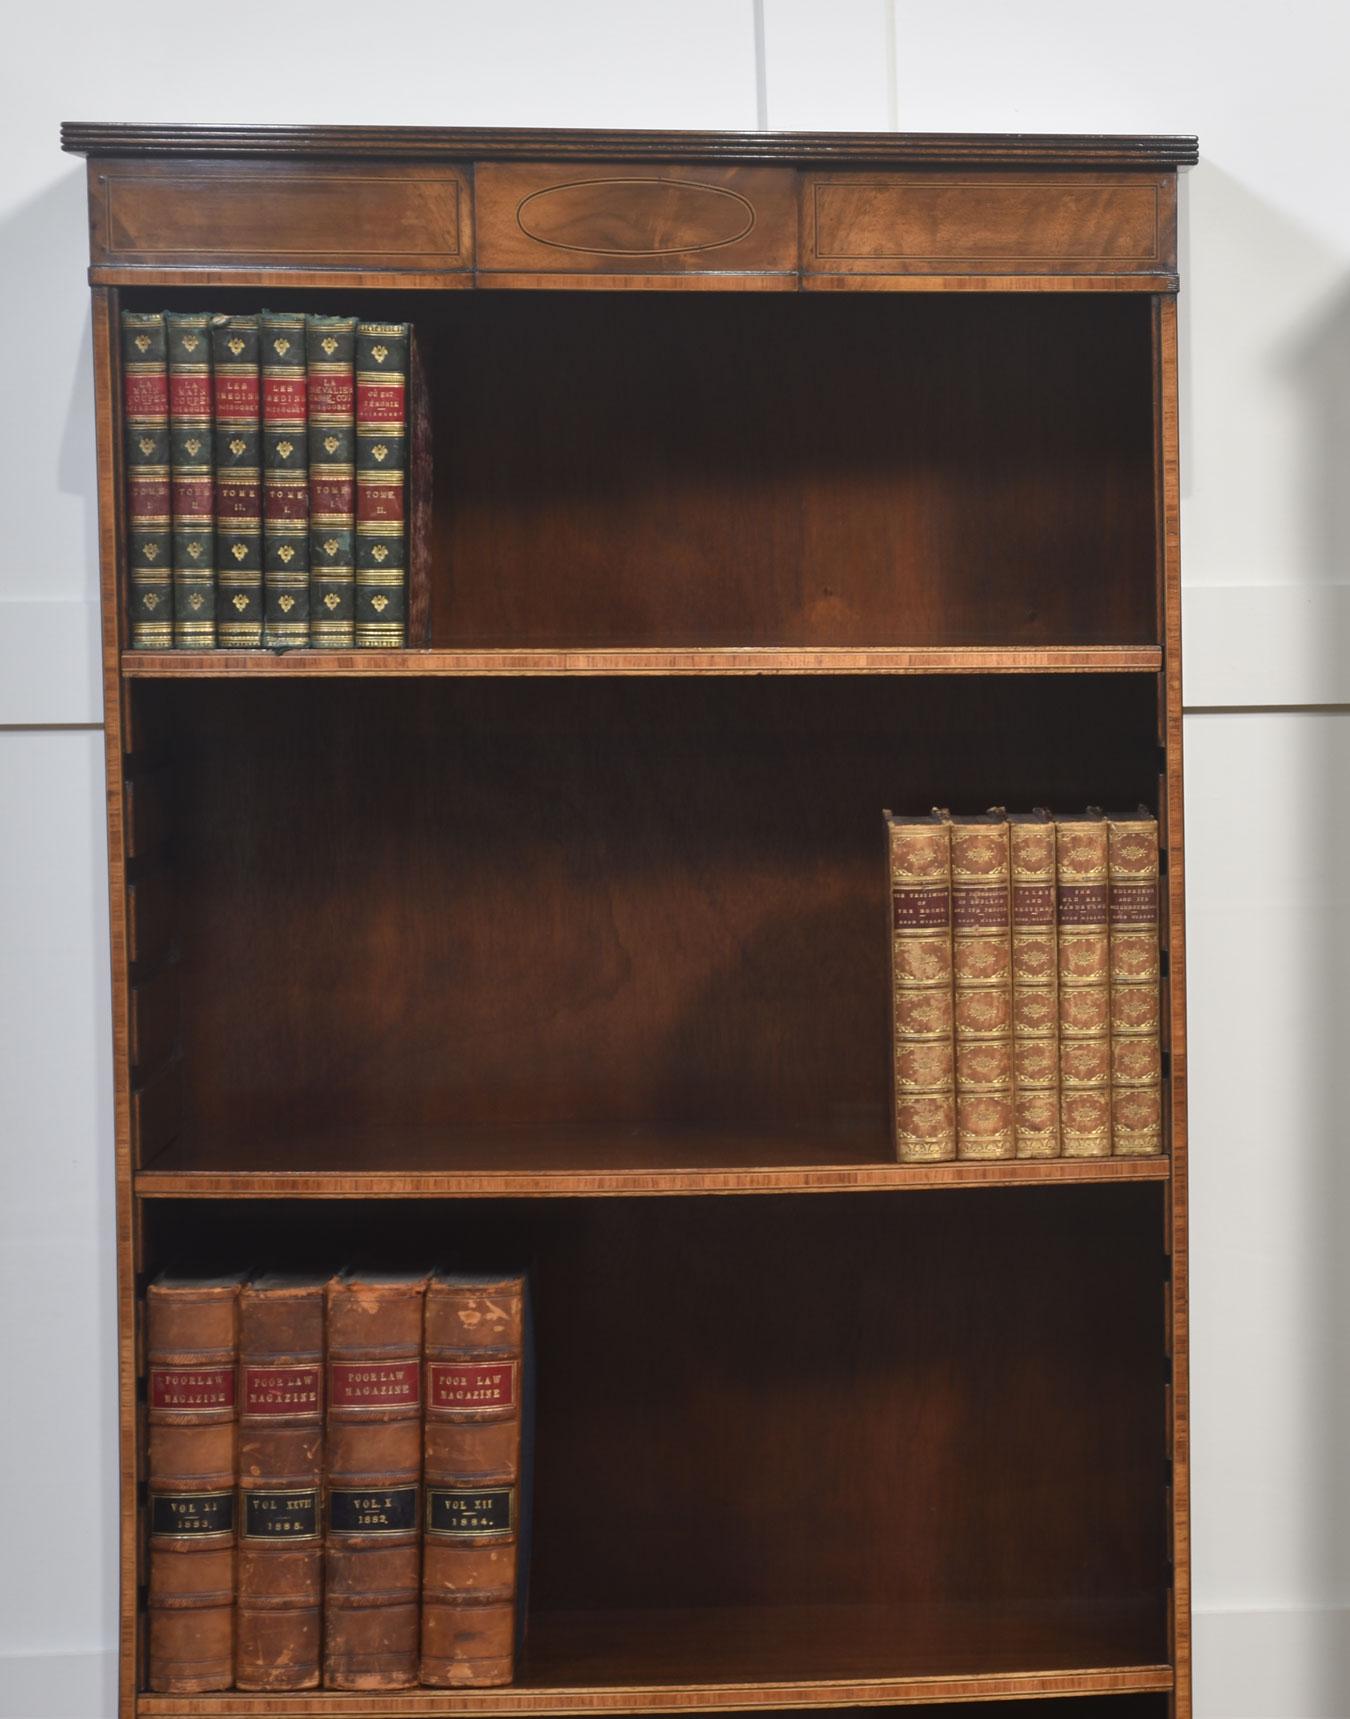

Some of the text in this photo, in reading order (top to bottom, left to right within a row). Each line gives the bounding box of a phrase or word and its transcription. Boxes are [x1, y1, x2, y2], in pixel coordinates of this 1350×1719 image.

[222, 490, 255, 498] TOME
[270, 491, 304, 499] TOME
[317, 486, 350, 494] TOME
[366, 491, 395, 499] TOME
[254, 1376, 313, 1387] POOR LAW
[348, 1371, 404, 1382] POOR LAW
[439, 1375, 502, 1385] POOR LAW
[345, 1385, 410, 1396] MAGAZINE
[440, 1389, 500, 1400] MAGAZINE
[164, 1393, 226, 1403] MAGAZINE
[250, 1392, 316, 1403] MAGAZINE
[171, 1503, 196, 1513] VOL
[252, 1500, 277, 1510] VOL
[445, 1500, 492, 1509] VOL XII
